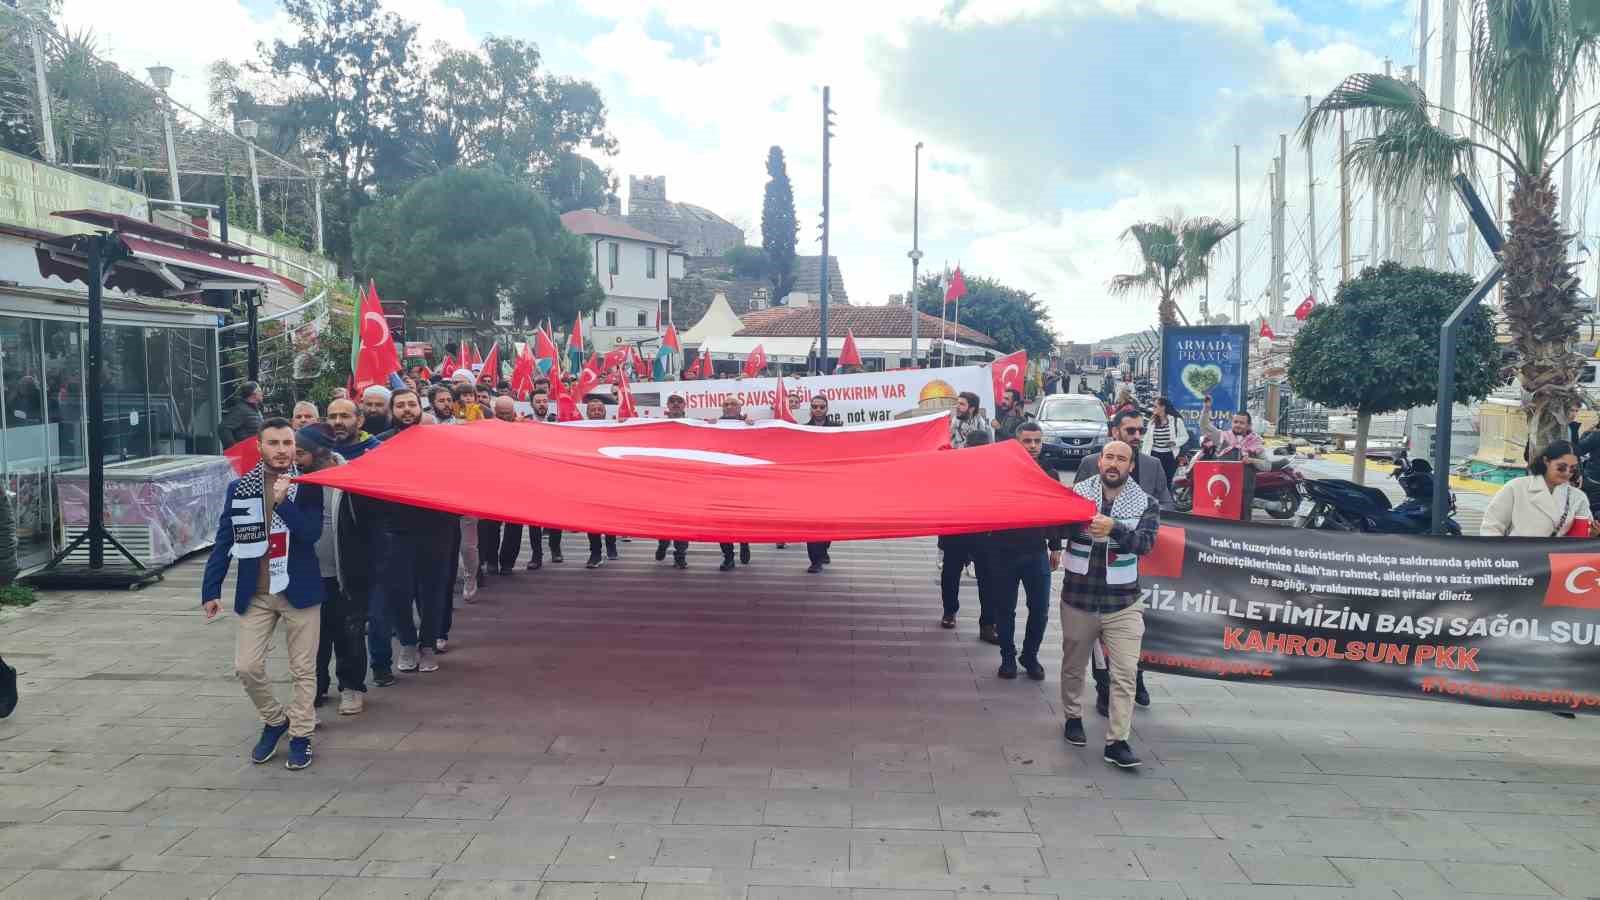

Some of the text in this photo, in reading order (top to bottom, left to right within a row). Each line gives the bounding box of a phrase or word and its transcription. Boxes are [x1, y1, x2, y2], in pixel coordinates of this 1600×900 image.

[1177, 340, 1232, 350] ARMADA
[685, 391, 733, 408] İSTİND
[882, 384, 906, 399] VAR
[847, 409, 865, 423] not
[869, 409, 891, 421] war
[1242, 542, 1292, 557] kuzeyinde
[1294, 548, 1355, 563] teröristlerin
[1357, 553, 1397, 566] alçakça
[1494, 558, 1519, 569] olan
[1250, 576, 1269, 588] baş
[1381, 587, 1400, 598] acil
[1434, 575, 1448, 583] ve
[1450, 574, 1472, 584] aziz
[1474, 574, 1535, 586] milletimize
[1137, 584, 1177, 611] ZİZ
[1182, 590, 1370, 631] MİLLETİMİZİN
[1376, 614, 1444, 639] BAŞI
[1223, 624, 1480, 672] KAHROLSUN PKK
